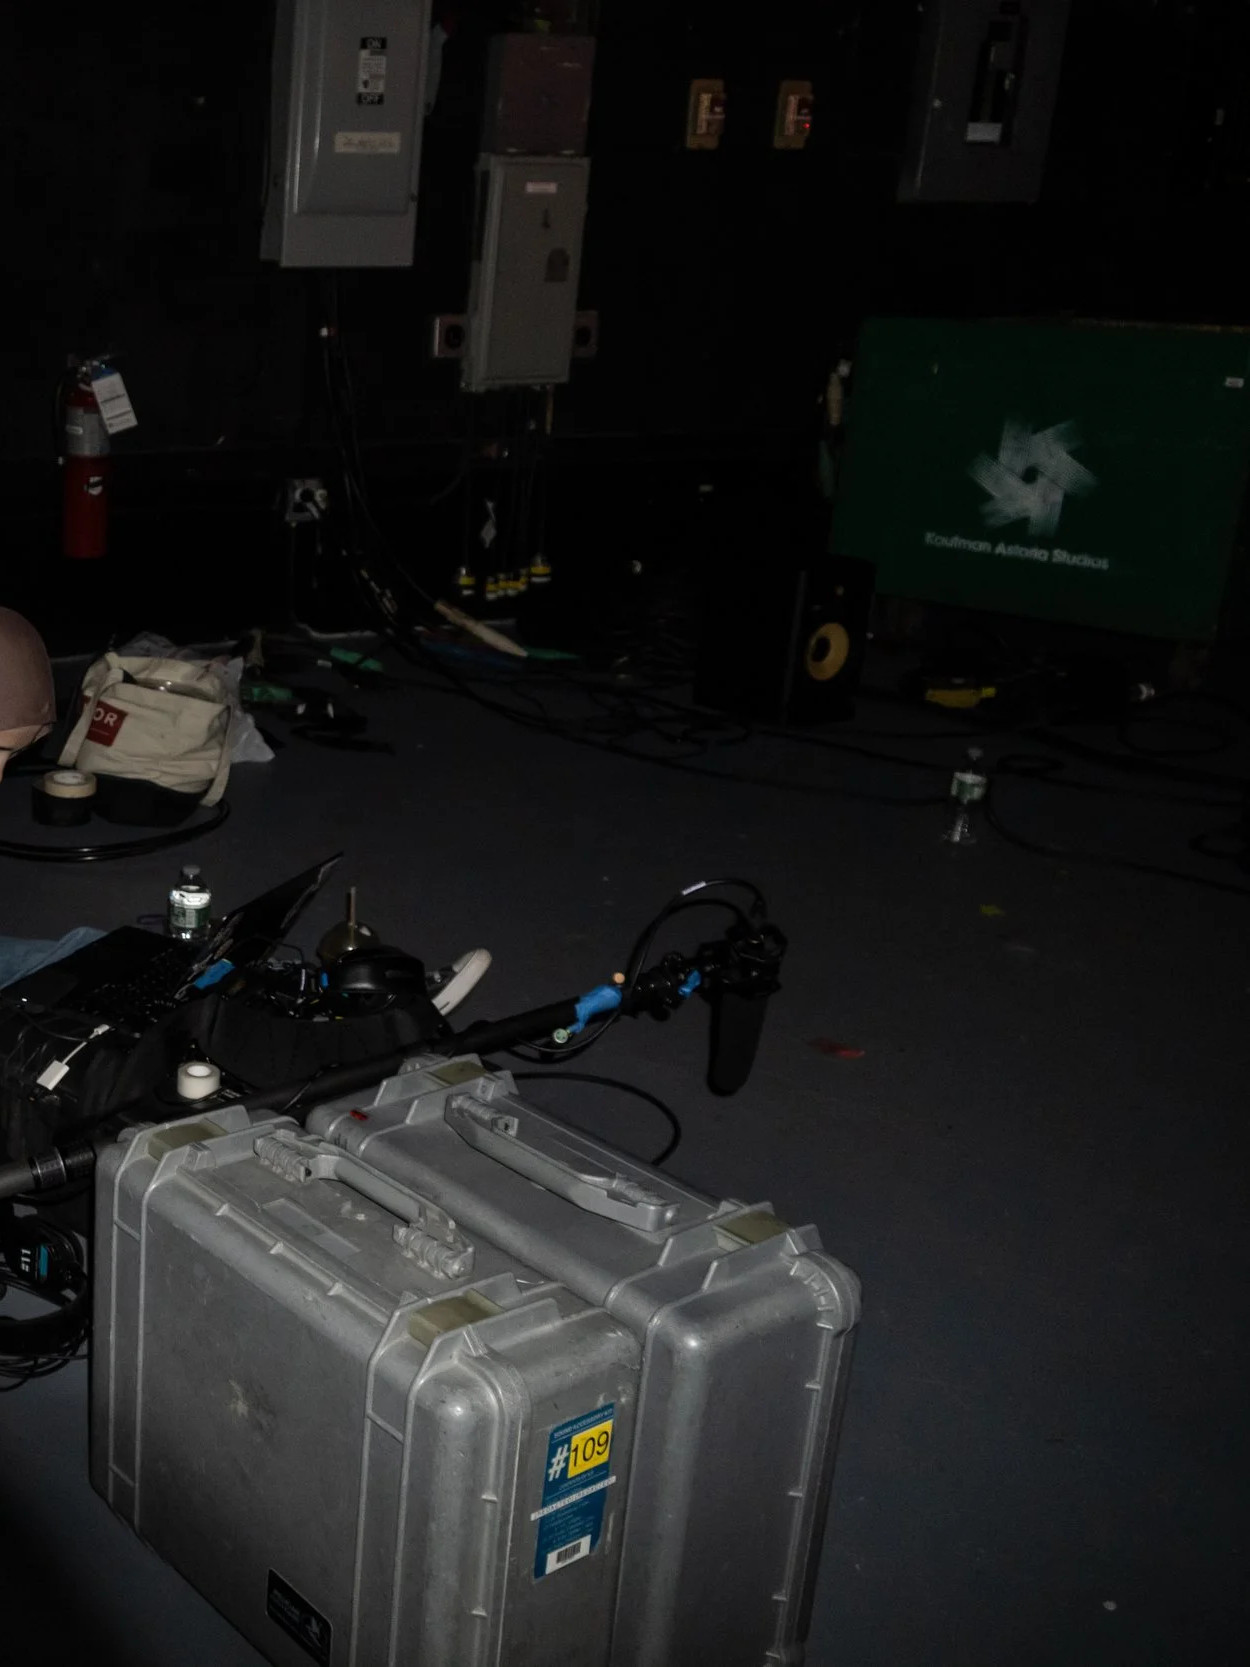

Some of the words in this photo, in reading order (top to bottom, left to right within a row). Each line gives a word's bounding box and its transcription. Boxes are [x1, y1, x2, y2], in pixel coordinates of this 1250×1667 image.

[924, 531, 992, 553] Kaufman
[994, 541, 1050, 562] Astoria
[1052, 548, 1109, 571] Studios
